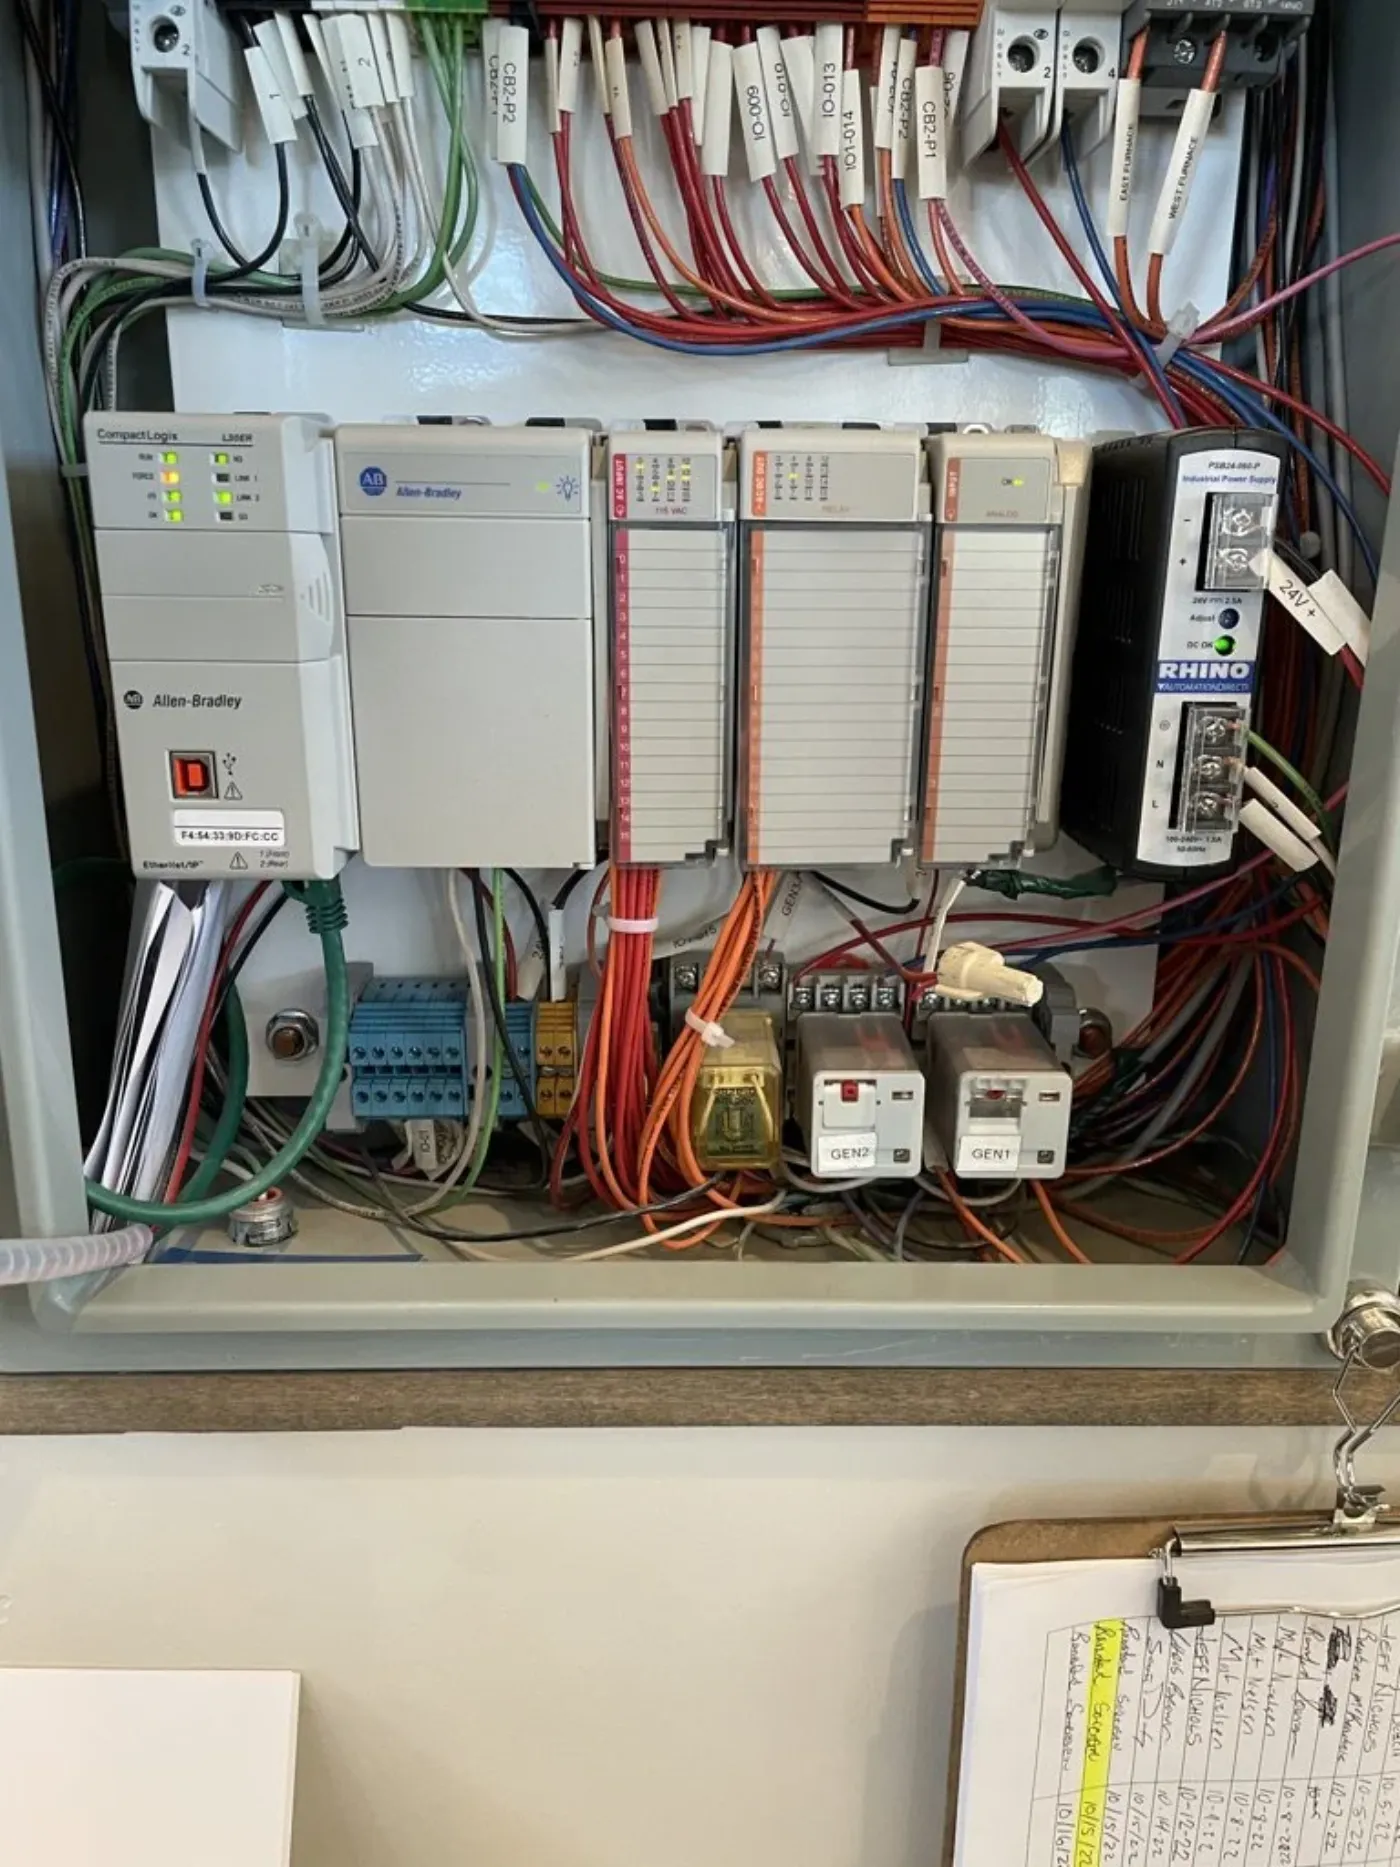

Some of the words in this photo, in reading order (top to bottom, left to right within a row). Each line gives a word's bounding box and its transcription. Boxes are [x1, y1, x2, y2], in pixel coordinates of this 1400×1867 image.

[182, 44, 190, 56] 2
[358, 57, 371, 67] 2
[1044, 66, 1051, 78] 2
[1108, 68, 1115, 78] 4
[502, 62, 516, 123] CB2-P2
[822, 63, 836, 117] IO-013
[747, 86, 765, 140] IO-009
[898, 78, 912, 139] CB2-P2
[922, 101, 936, 159] CB2-P1
[843, 111, 856, 171] IO1-014
[1123, 124, 1134, 173] FURNACE
[1120, 176, 1129, 201] EAST
[1168, 189, 1183, 220] WEST
[1177, 136, 1198, 187] FURNACE
[1248, 475, 1276, 483] Supply
[396, 486, 462, 500] Allen-Bradley
[1279, 579, 1310, 607] 24V
[1158, 662, 1250, 679] RHINO
[152, 694, 242, 710] Allen-Bradley
[1156, 760, 1164, 768] N
[1151, 800, 1159, 808] L
[831, 1147, 870, 1160] GEN2
[971, 1148, 1010, 1160] GEN1
[1185, 1676, 1214, 1747] NICHOLS
[1170, 1786, 1197, 1861] 10-12-22
